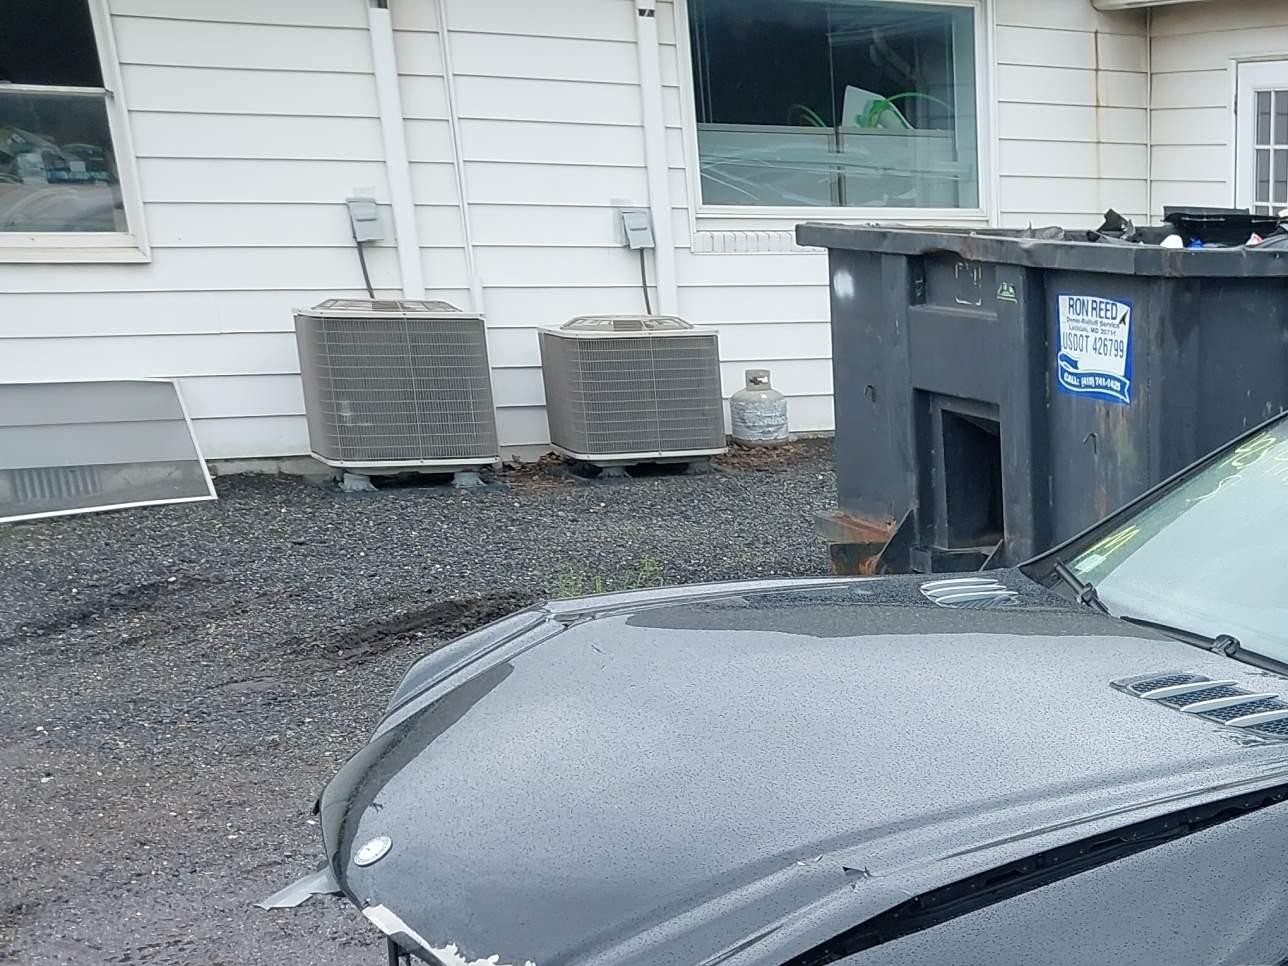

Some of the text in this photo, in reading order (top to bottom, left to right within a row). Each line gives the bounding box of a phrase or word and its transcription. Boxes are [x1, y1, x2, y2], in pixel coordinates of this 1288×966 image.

[1068, 297, 1118, 320] RON REED
[1063, 332, 1124, 359] USDOT 426799
[1063, 372, 1080, 385] CALL:
